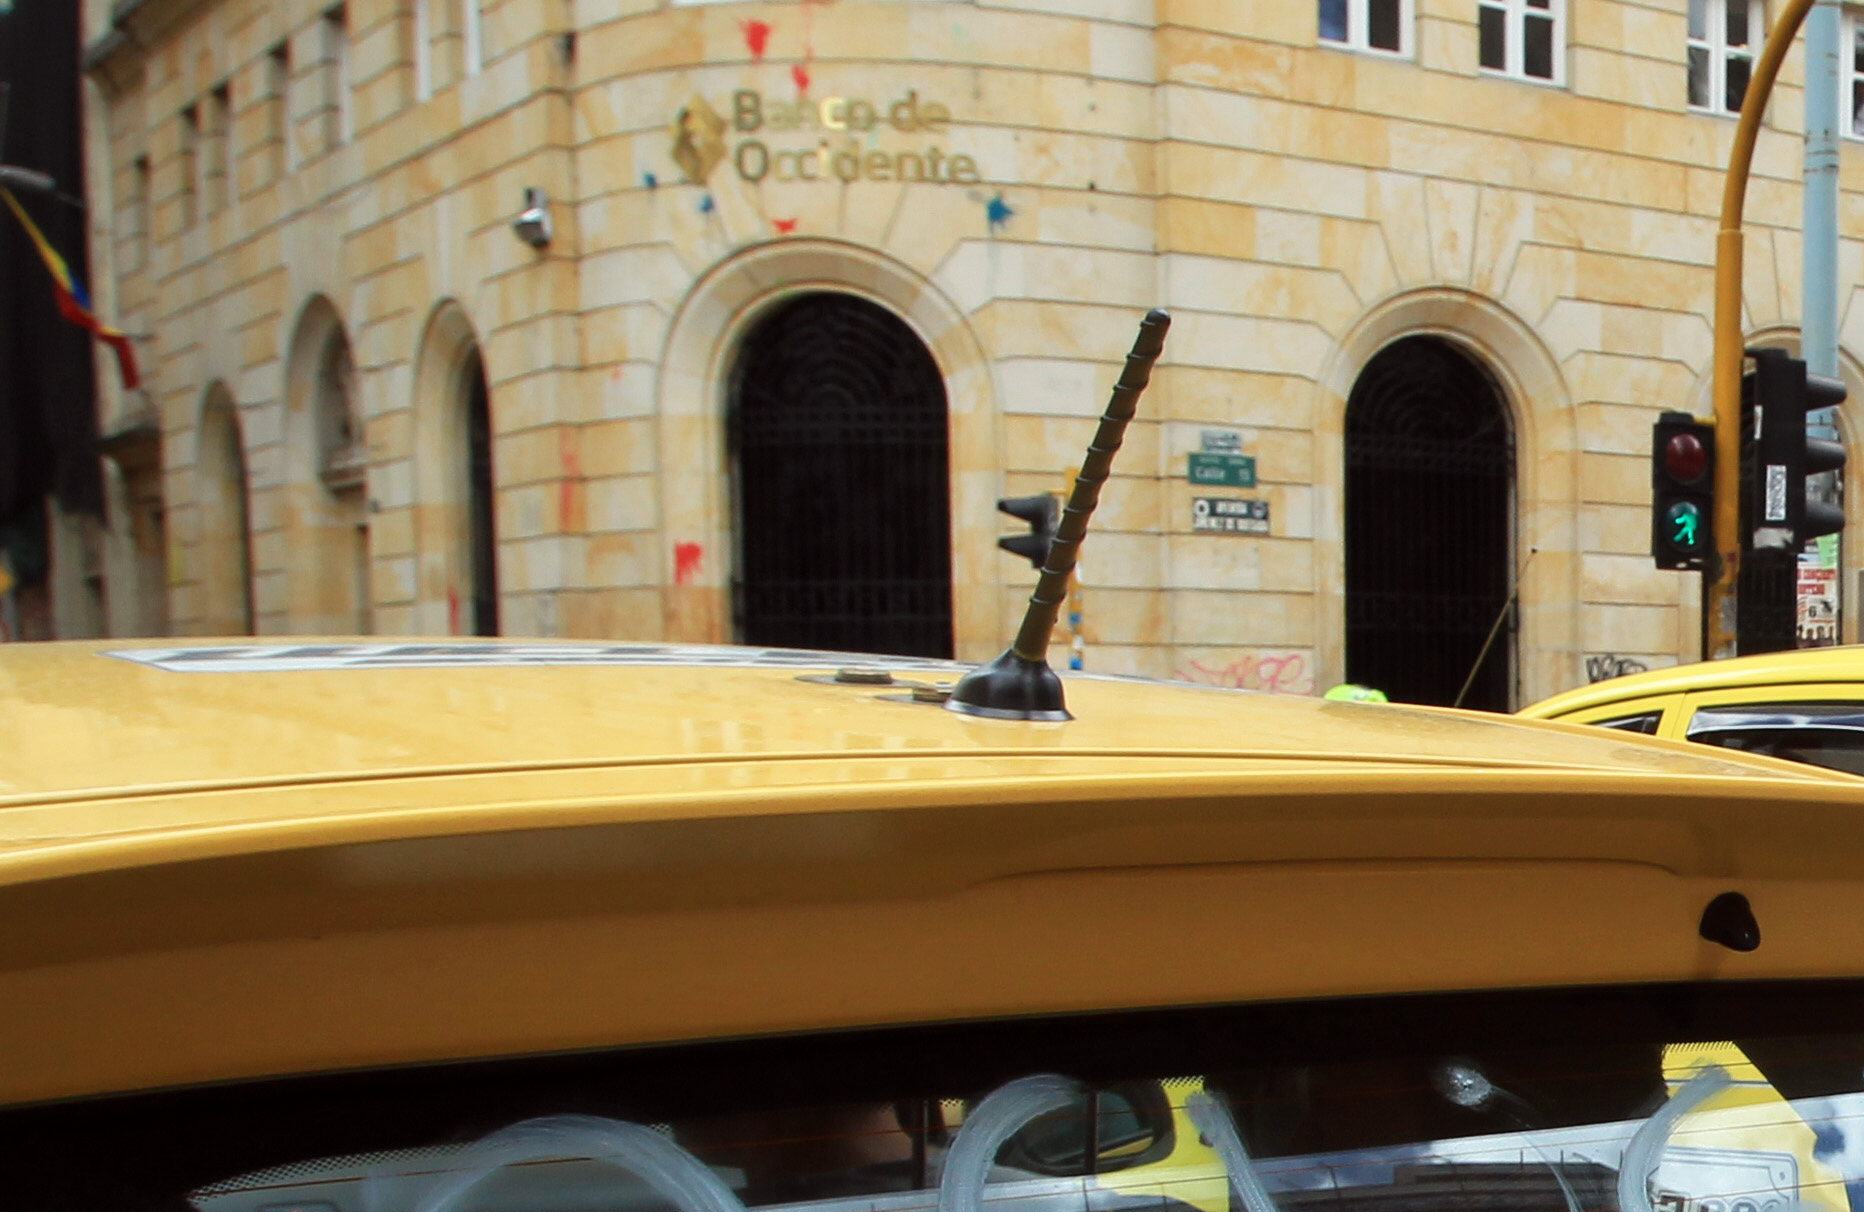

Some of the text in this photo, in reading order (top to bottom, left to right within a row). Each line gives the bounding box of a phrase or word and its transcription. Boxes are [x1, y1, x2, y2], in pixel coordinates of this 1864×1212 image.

[734, 88, 951, 133] Banco de
[735, 136, 981, 184] Occidente
